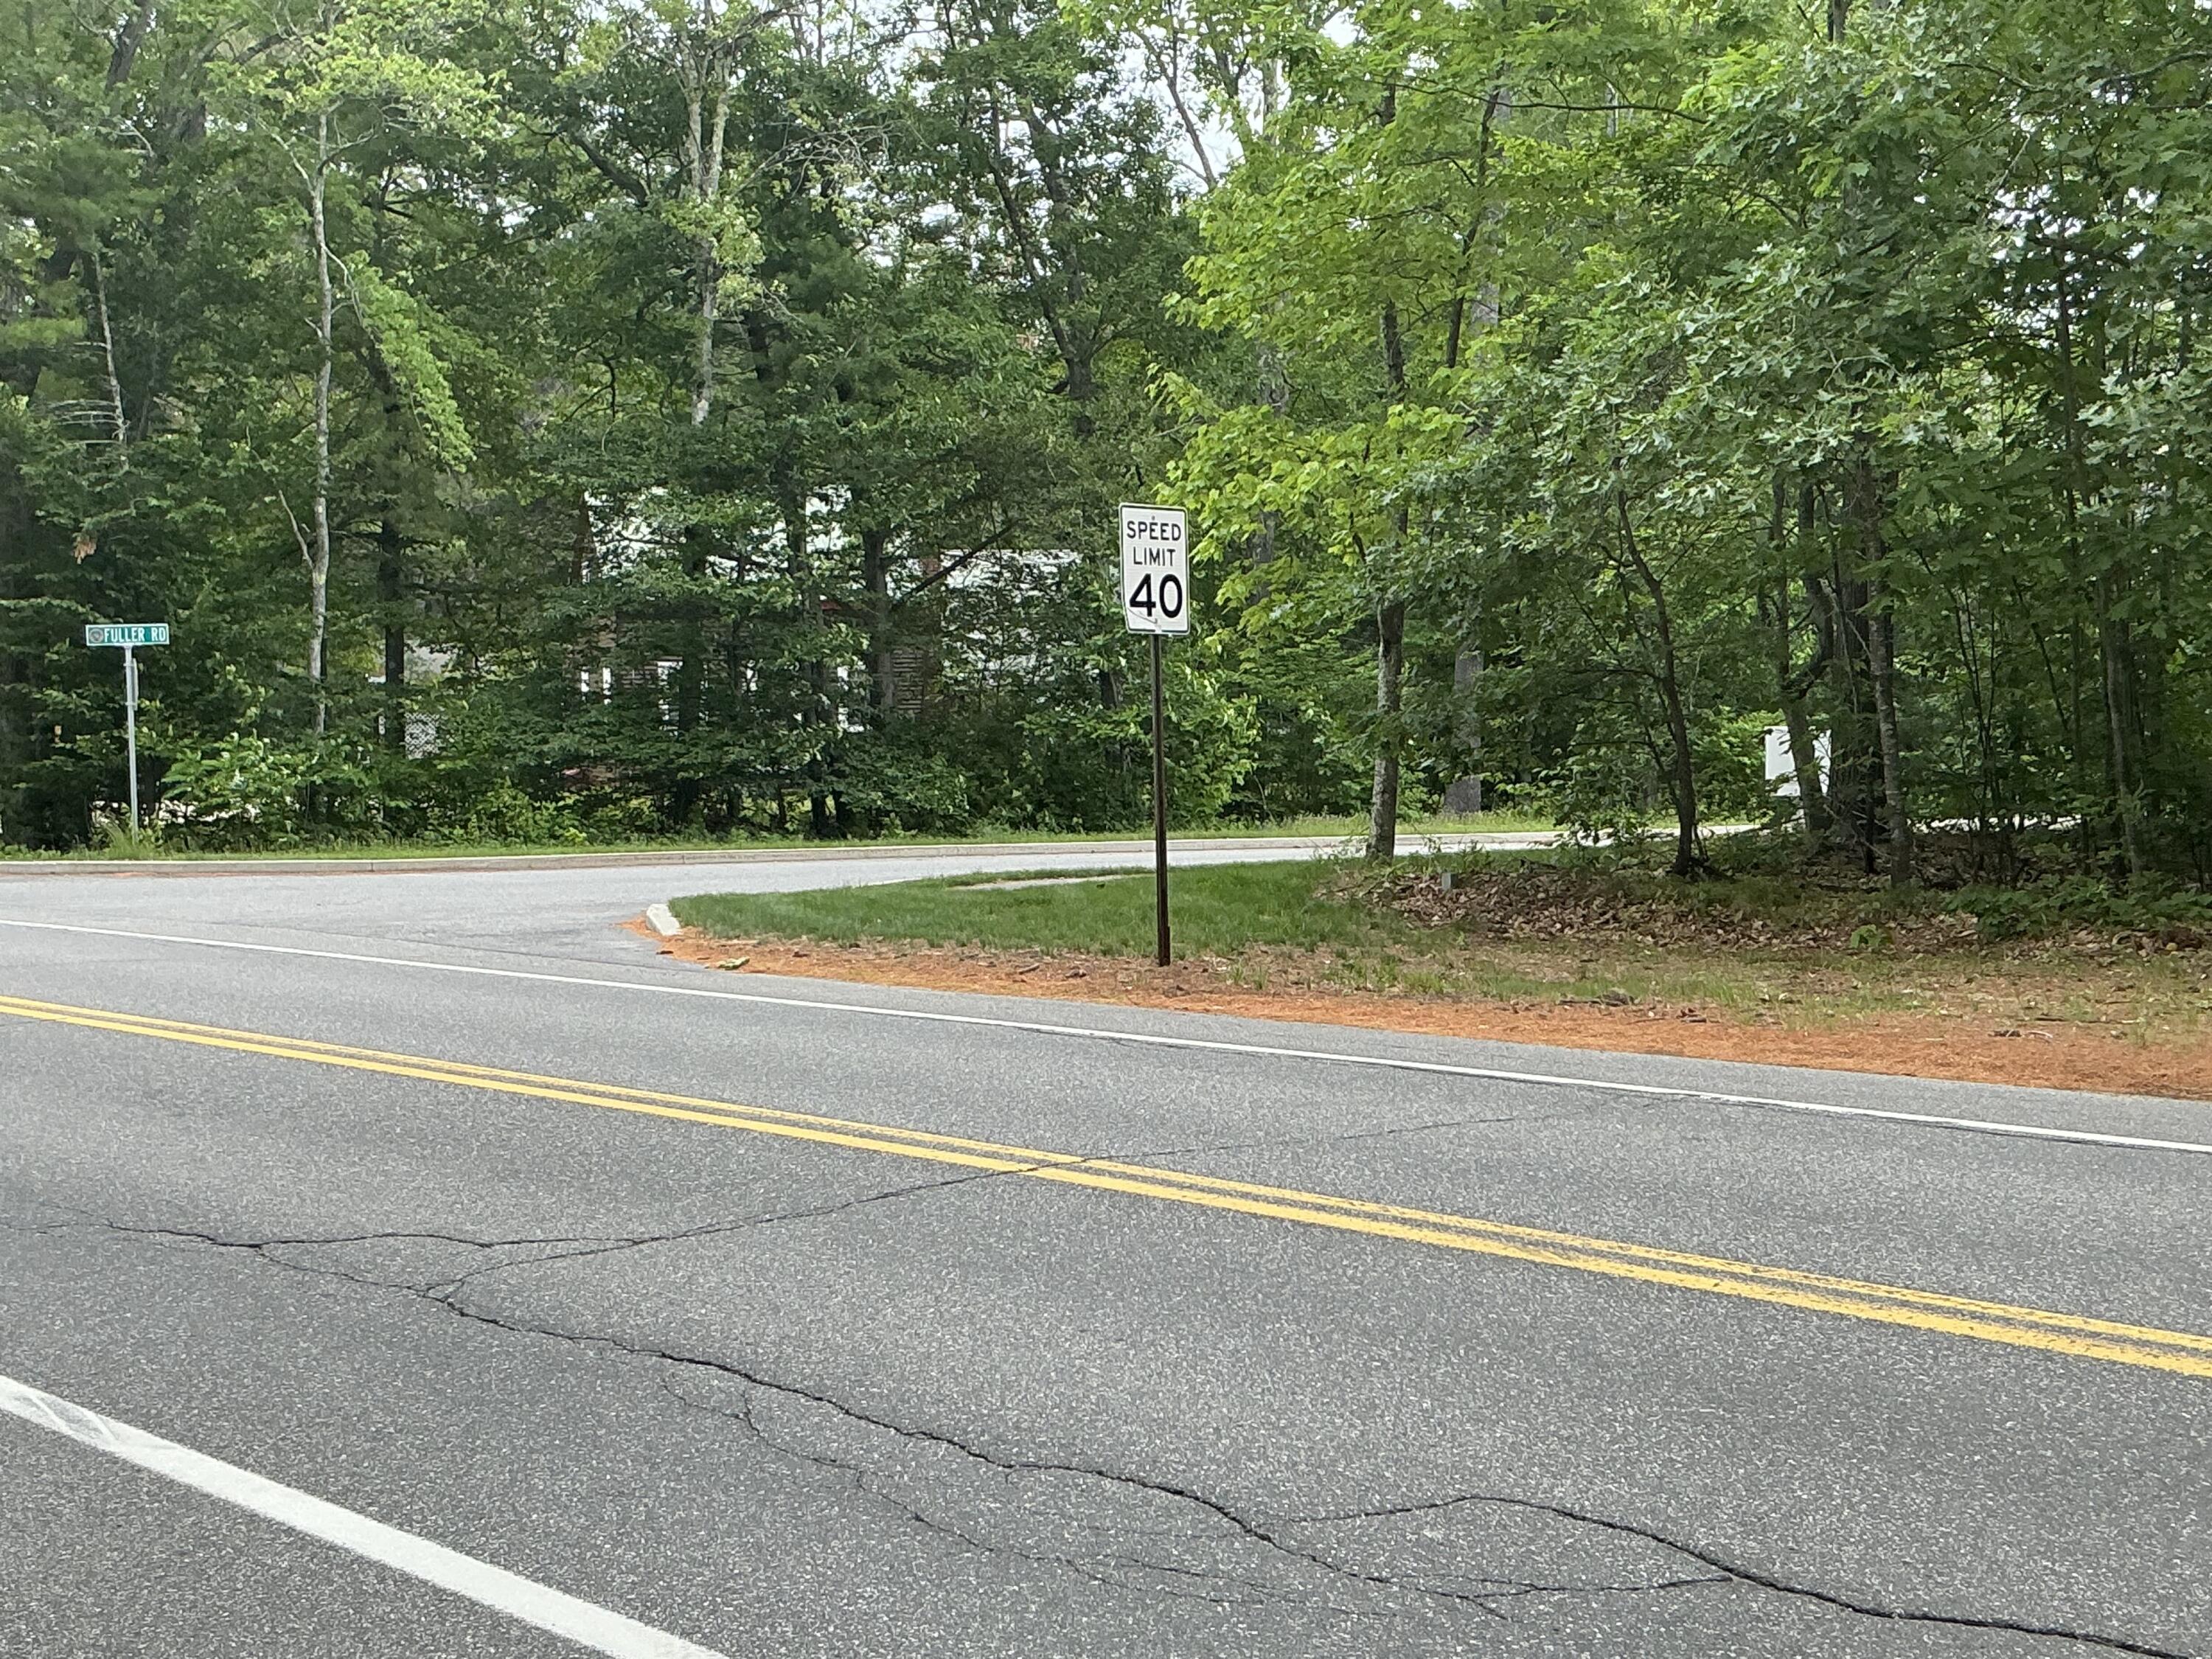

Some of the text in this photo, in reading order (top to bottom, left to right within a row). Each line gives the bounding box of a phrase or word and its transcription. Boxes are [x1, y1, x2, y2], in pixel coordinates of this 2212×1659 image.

[1127, 521, 1181, 541] SPEED
[1133, 546, 1176, 566] LIMIT
[1129, 573, 1183, 619] 40
[104, 627, 166, 642] FULLER RD
